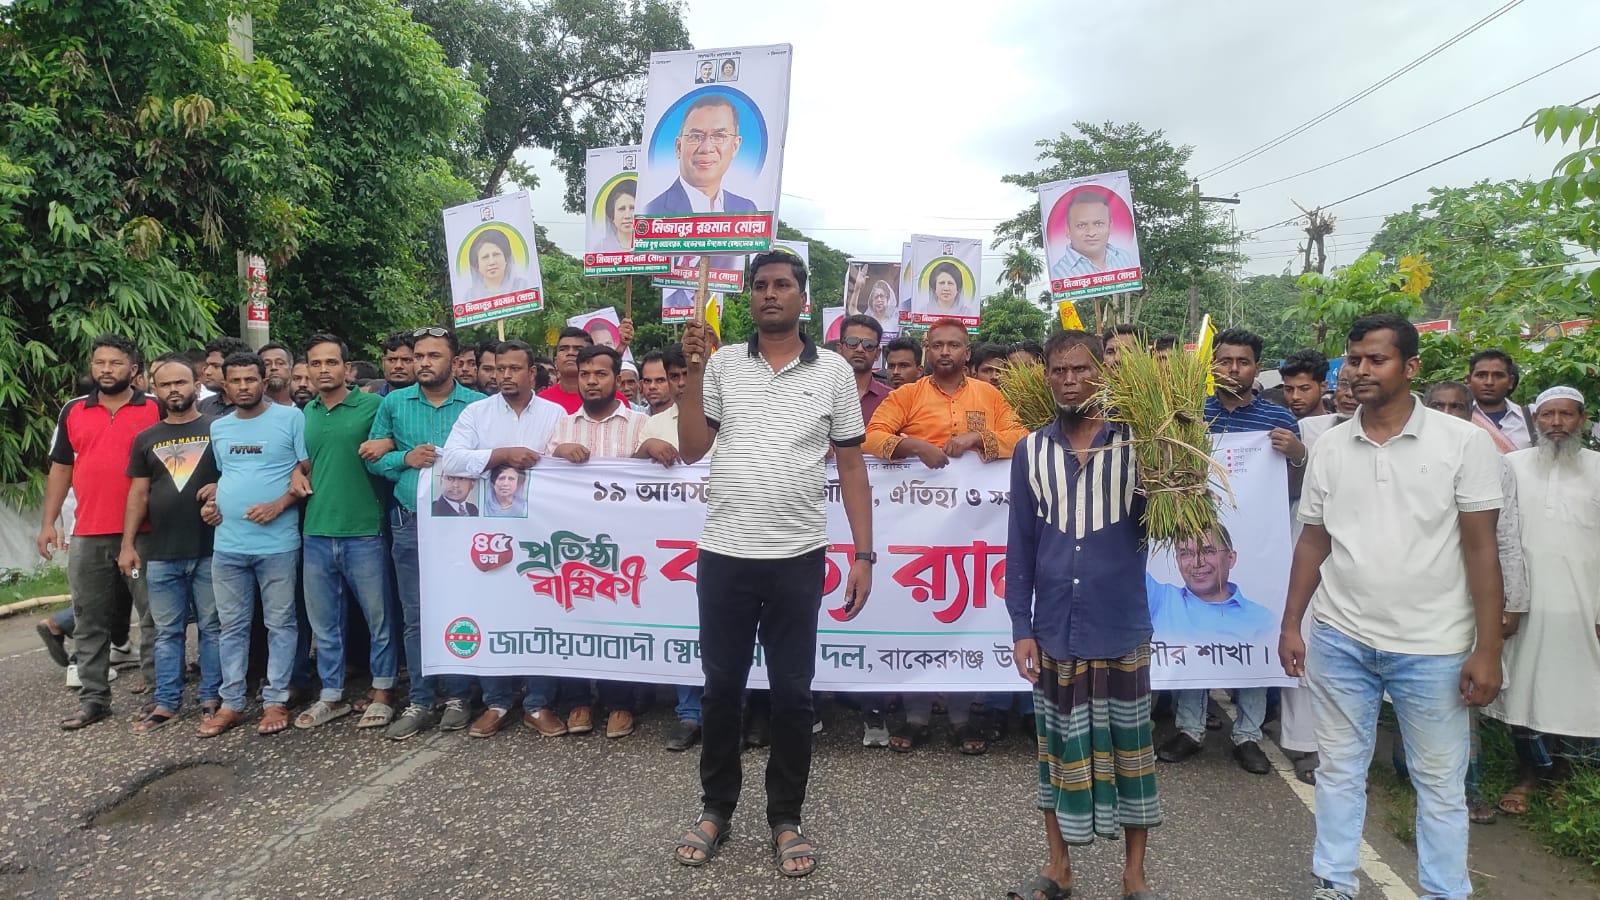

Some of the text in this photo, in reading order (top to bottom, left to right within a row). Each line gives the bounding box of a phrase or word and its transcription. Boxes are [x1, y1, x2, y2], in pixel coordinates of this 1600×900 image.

[651, 219, 766, 237] মিজানুর রহমান মোল্লা
[596, 254, 622, 265] মিজানুর
[624, 254, 646, 263] রহমান
[465, 301, 492, 312] মিজানুর
[593, 481, 627, 501] ১৯
[890, 480, 958, 509] ঐতিহ্য
[966, 489, 981, 506] ও
[474, 534, 513, 551] ৪৫
[516, 530, 619, 575] প্রতিষ্ঠা
[526, 555, 647, 612] বার্ষিকী
[488, 627, 655, 661] জাতীয়তাবাদী
[820, 643, 873, 672] দল,
[878, 648, 984, 670] বাকেরগঞ্জ
[1194, 641, 1254, 666] শাখা
